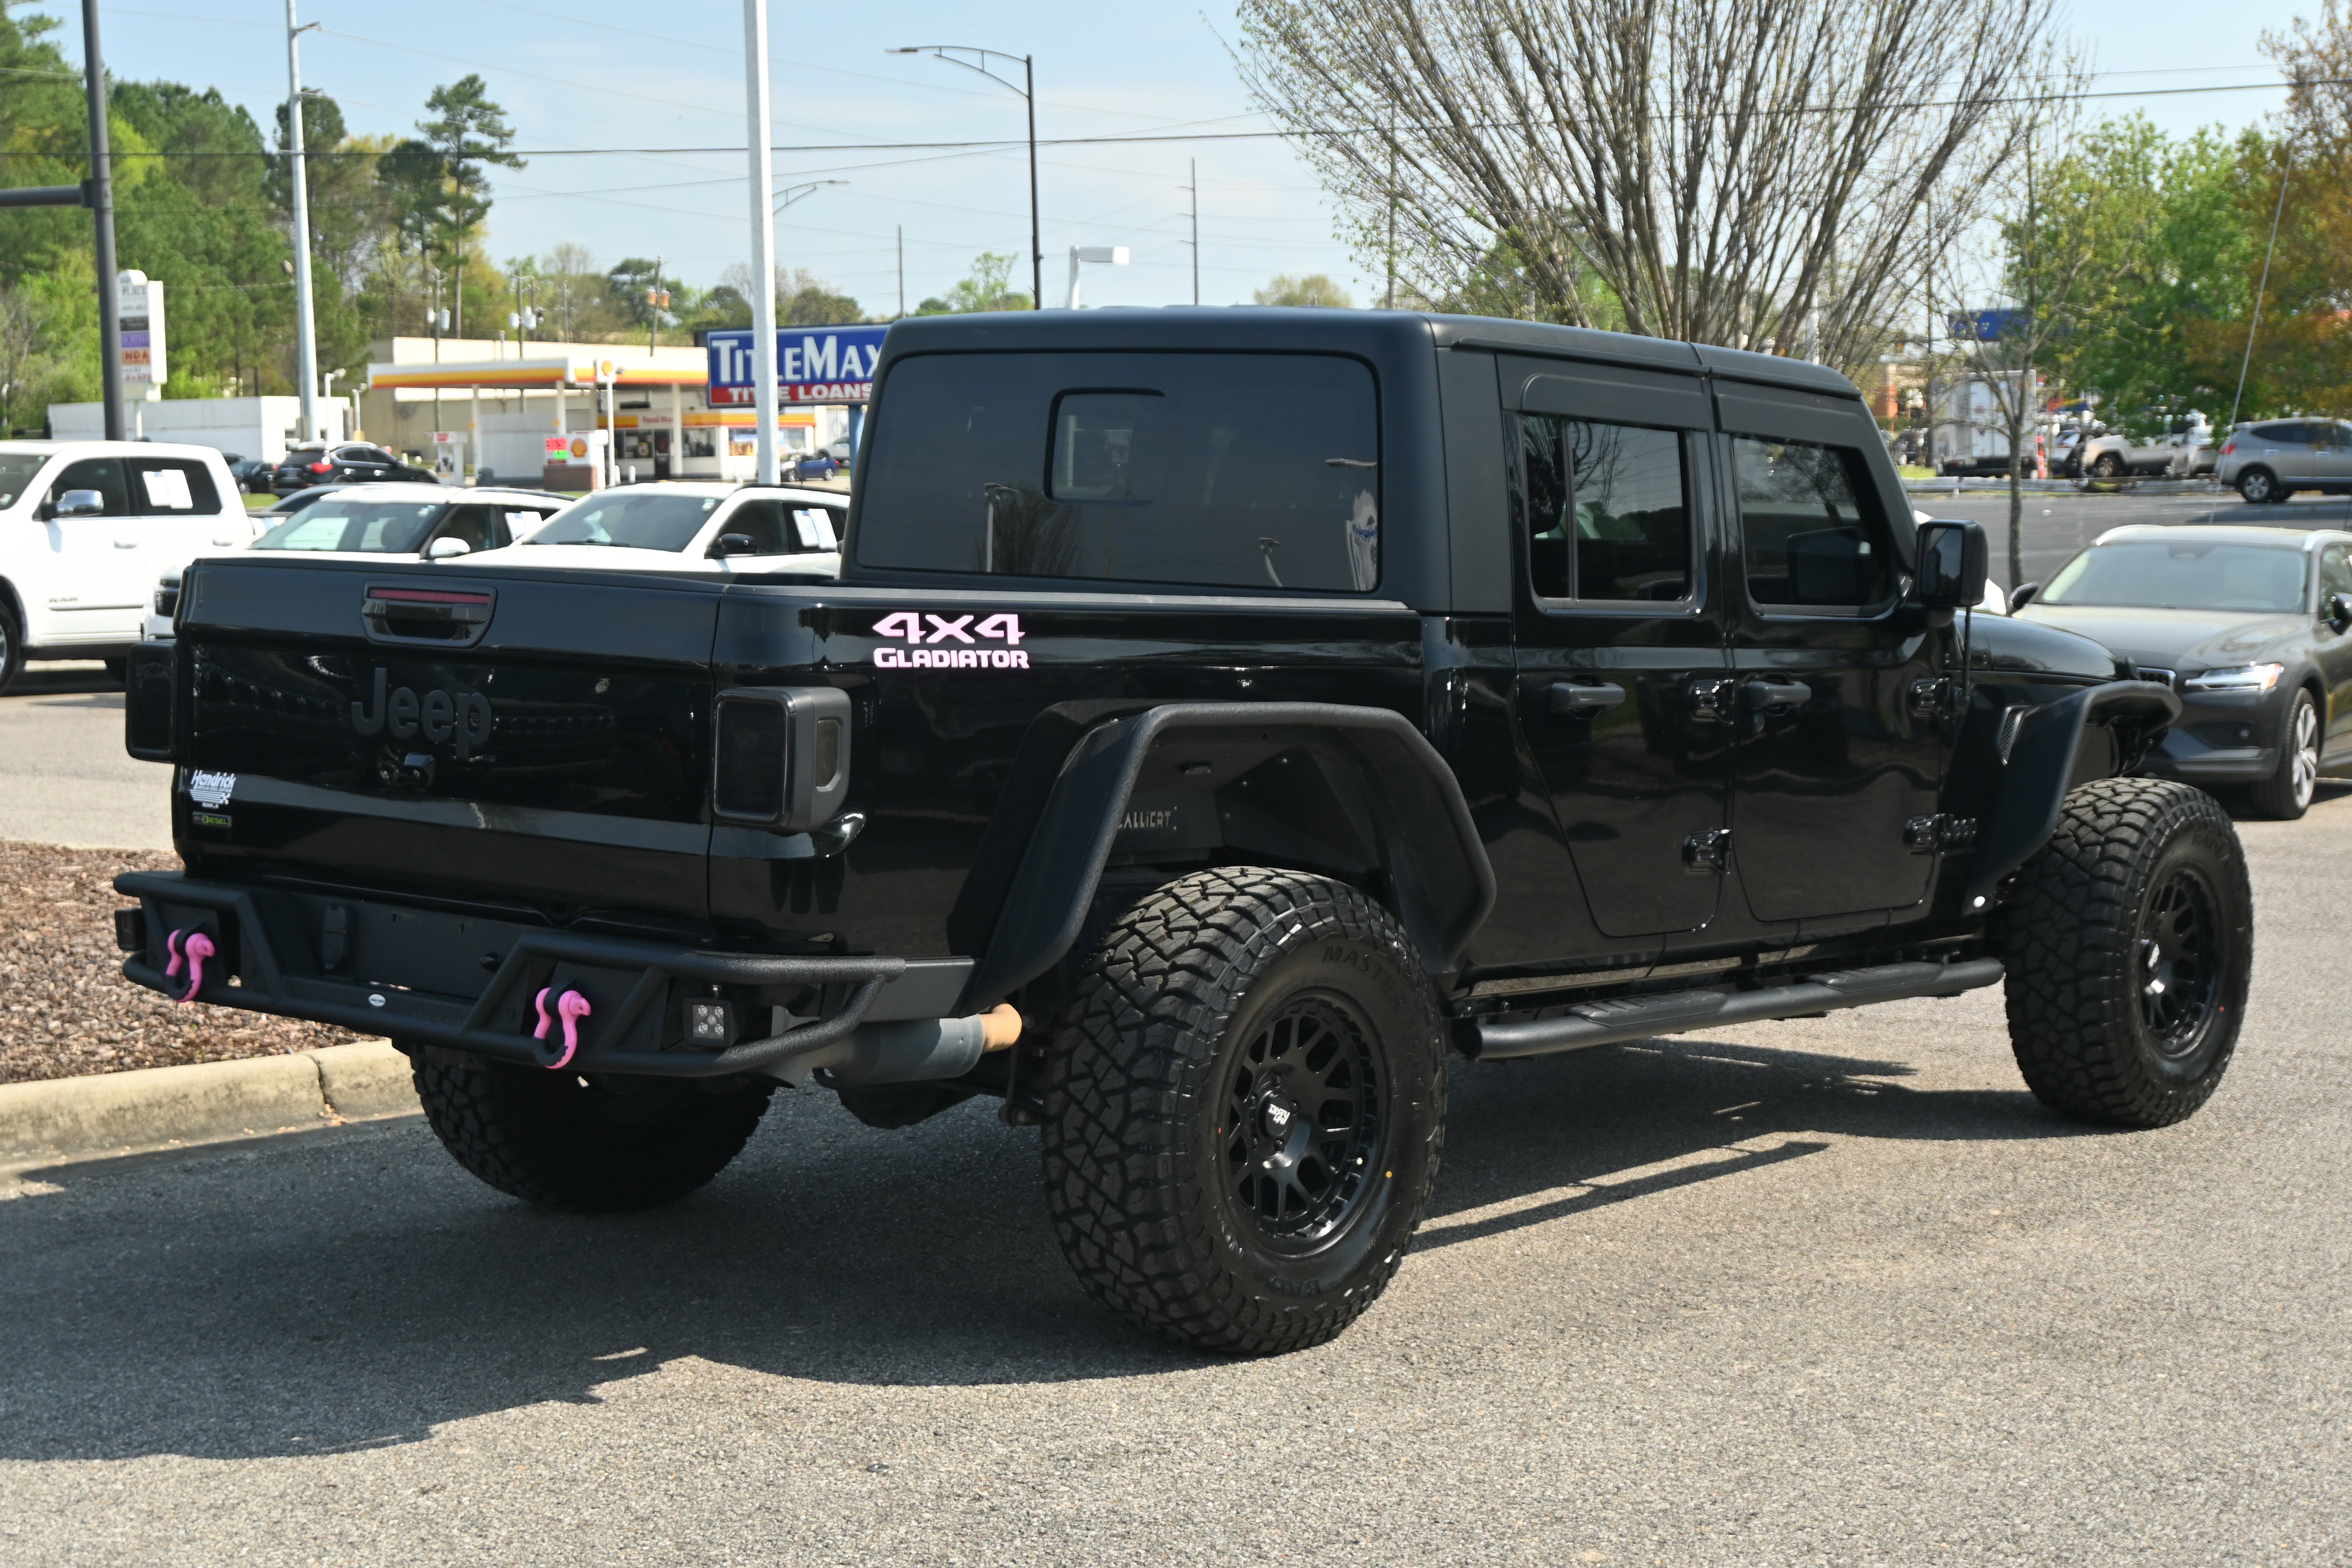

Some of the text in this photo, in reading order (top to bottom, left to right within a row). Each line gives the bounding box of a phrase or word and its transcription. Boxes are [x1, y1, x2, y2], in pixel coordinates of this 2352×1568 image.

[712, 335, 882, 382] TITEMAX
[728, 382, 873, 402] TITE LOANS
[642, 414, 659, 422] Food
[351, 667, 493, 761] Jeep
[190, 769, 236, 789] Hendrick
